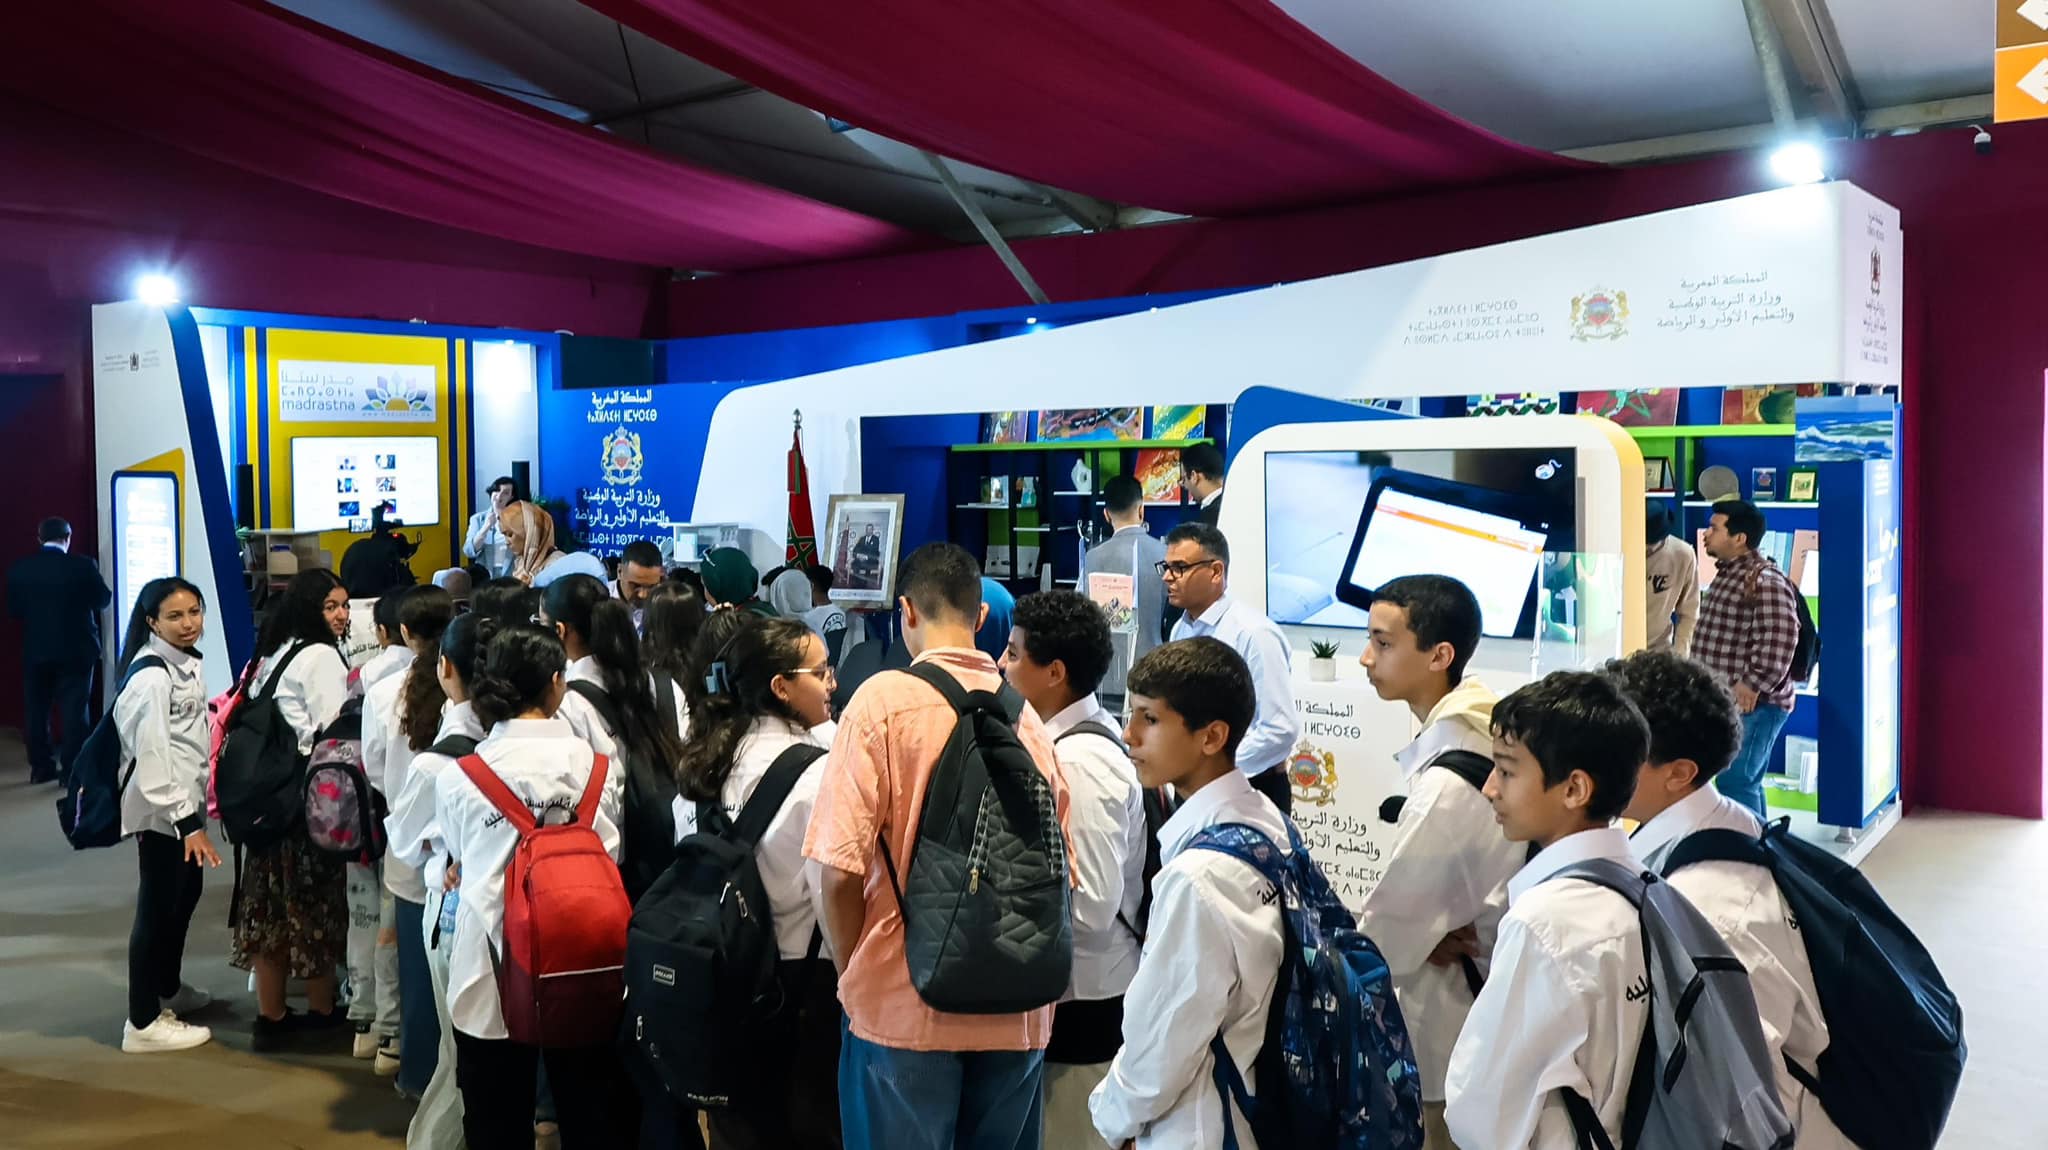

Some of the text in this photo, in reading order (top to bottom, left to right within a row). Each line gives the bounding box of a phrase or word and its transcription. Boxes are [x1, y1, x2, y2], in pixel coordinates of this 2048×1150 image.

[281, 397, 355, 411] madrastna
[591, 388, 653, 410] المملكة المغربية
[582, 487, 661, 508] وزارة التربية الوطنية
[639, 508, 671, 529] والتعليم
[1304, 700, 1354, 718] المملكة
[1291, 808, 1367, 837] وزارة التربية
[1303, 830, 1381, 862] والتعليم الأول
